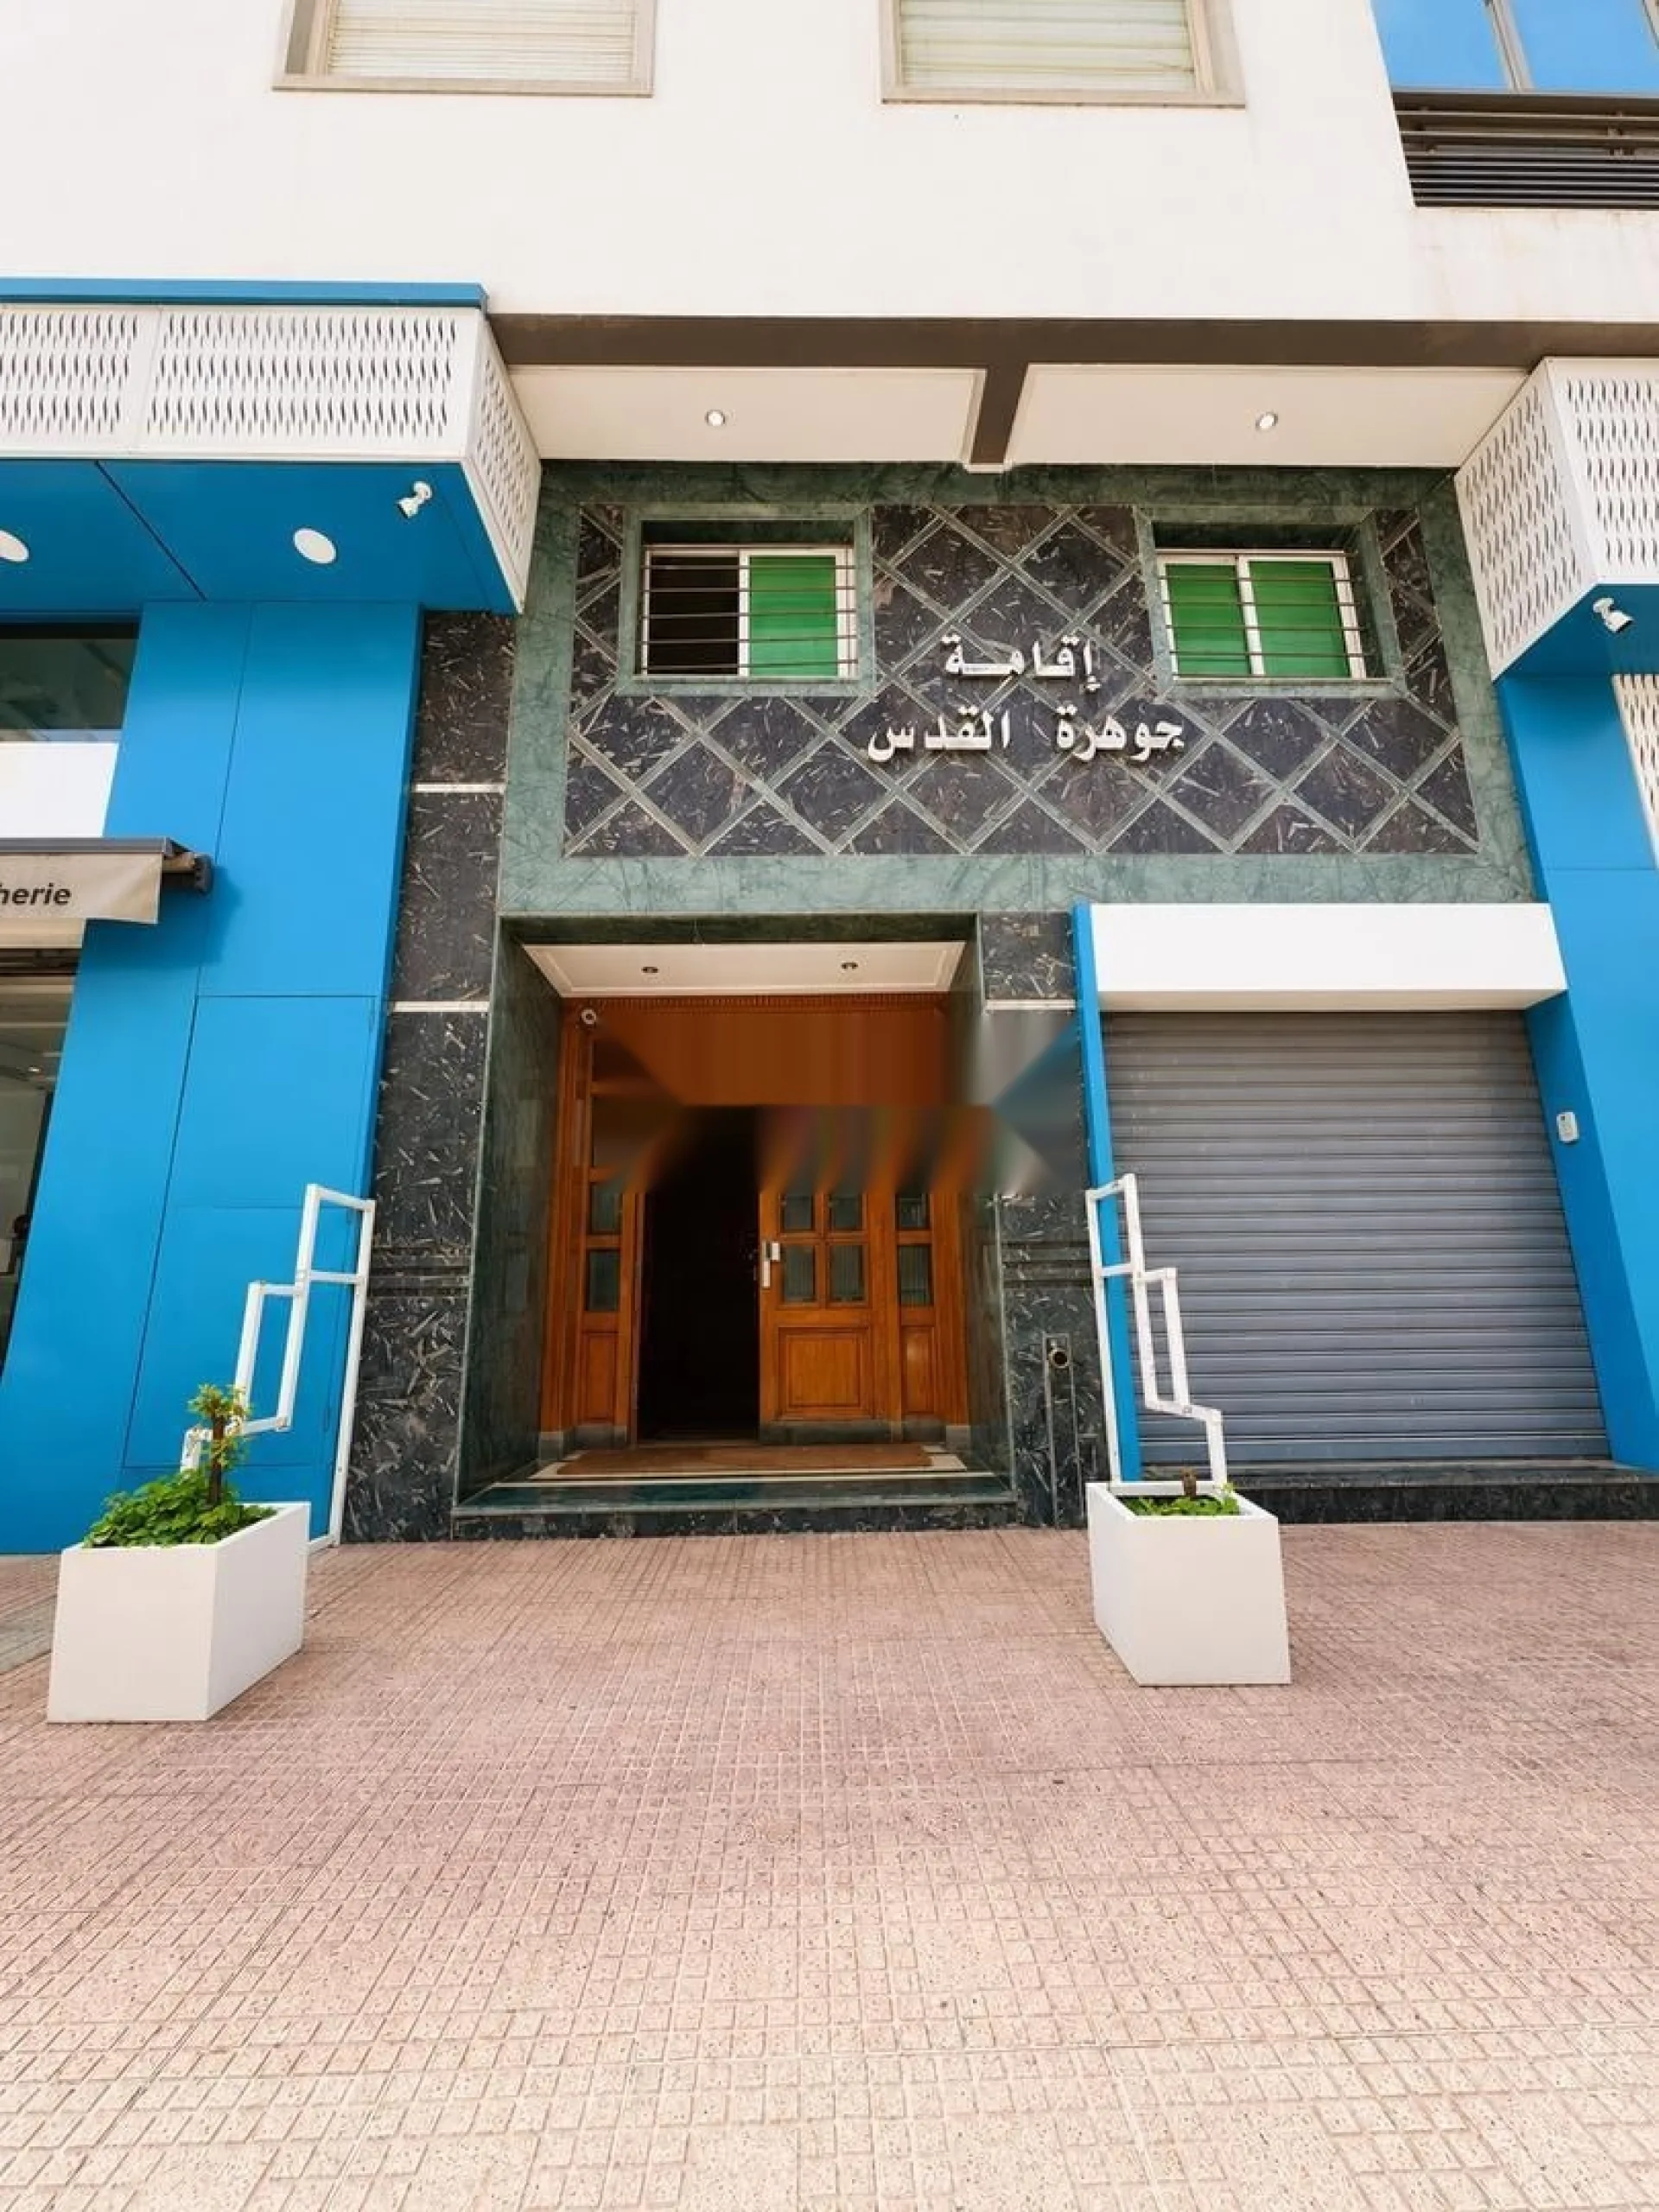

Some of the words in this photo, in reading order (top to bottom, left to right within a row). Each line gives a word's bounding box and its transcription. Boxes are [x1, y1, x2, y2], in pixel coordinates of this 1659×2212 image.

[941, 633, 1101, 692] إقامة
[867, 705, 1011, 763] القدس
[1056, 704, 1185, 761] جوهرة
